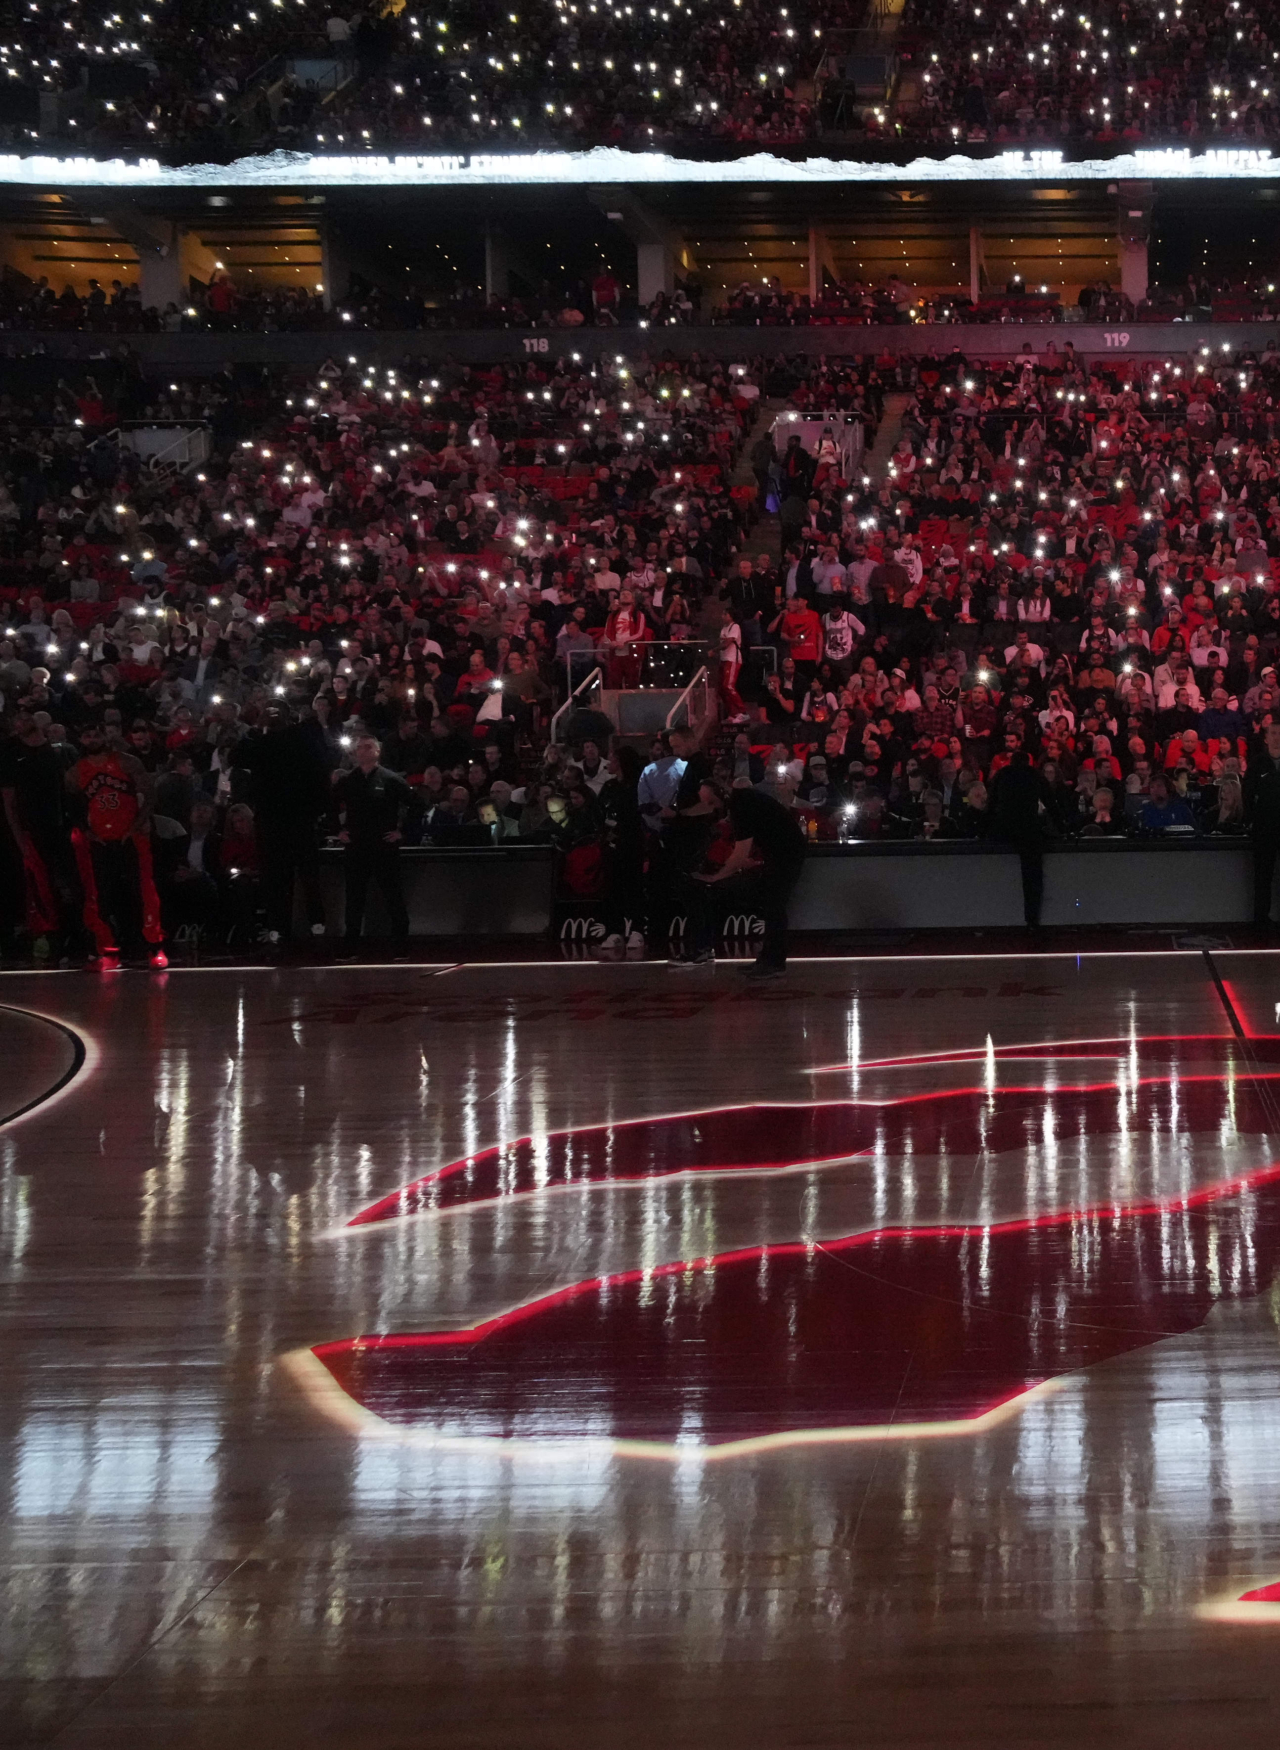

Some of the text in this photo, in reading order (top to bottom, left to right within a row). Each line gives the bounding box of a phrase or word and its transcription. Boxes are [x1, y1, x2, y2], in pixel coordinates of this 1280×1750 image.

[522, 338, 549, 352] 118
[1104, 332, 1130, 347] 119
[97, 791, 120, 811] 33
